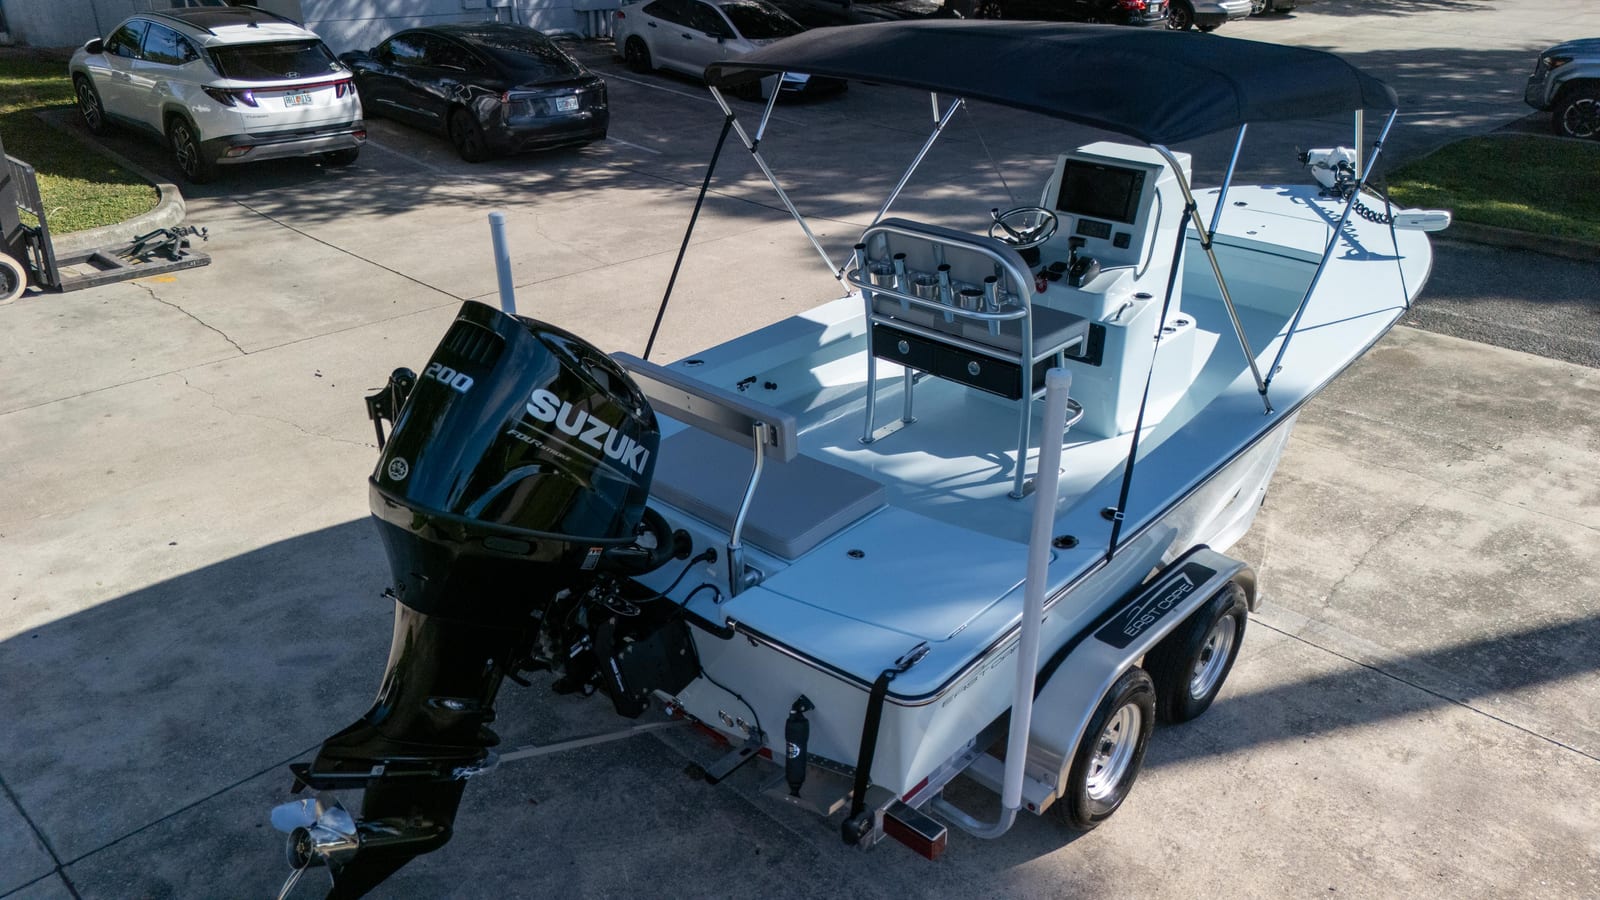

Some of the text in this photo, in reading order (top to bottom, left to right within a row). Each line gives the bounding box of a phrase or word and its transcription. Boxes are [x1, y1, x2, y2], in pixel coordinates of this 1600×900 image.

[424, 361, 474, 394] 200
[506, 428, 543, 448] FOUR
[526, 388, 650, 475] SUZUKI
[1123, 583, 1194, 637] EAST CAPE
